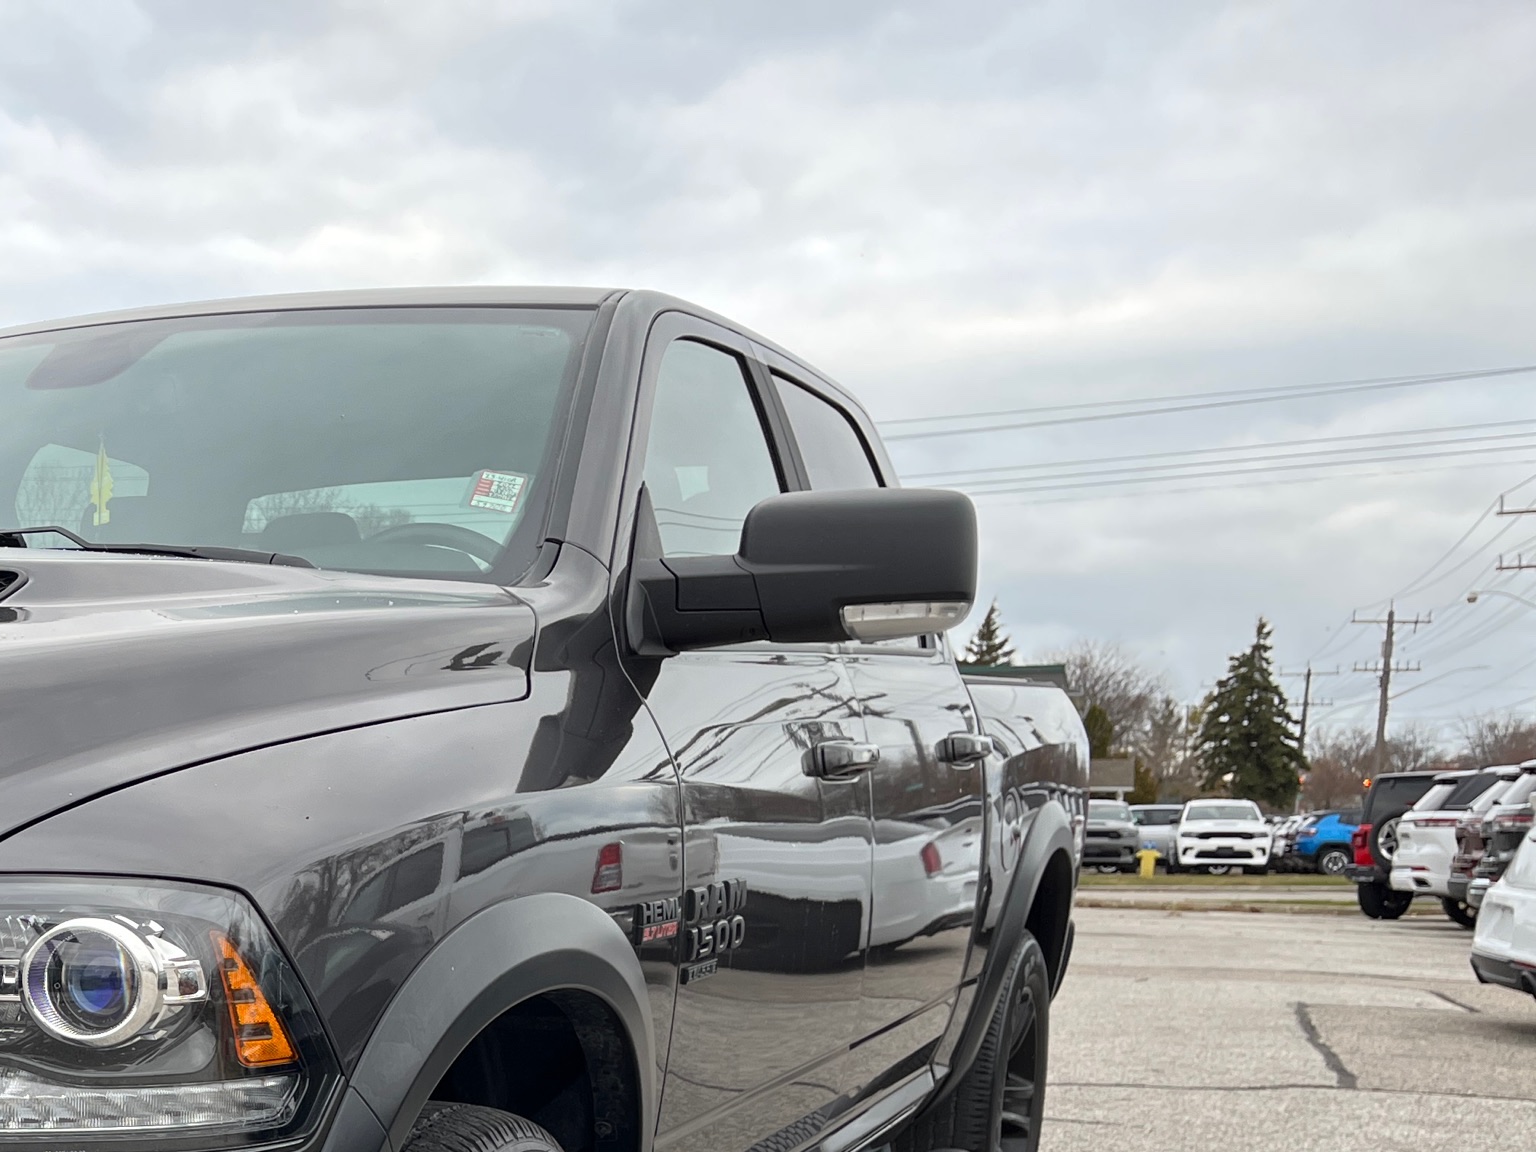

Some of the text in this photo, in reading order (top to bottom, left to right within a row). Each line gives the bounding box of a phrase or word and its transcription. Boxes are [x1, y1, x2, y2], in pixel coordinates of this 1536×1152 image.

[641, 897, 681, 926] HEMI
[686, 878, 747, 923] RAM
[686, 914, 745, 961] 1500
